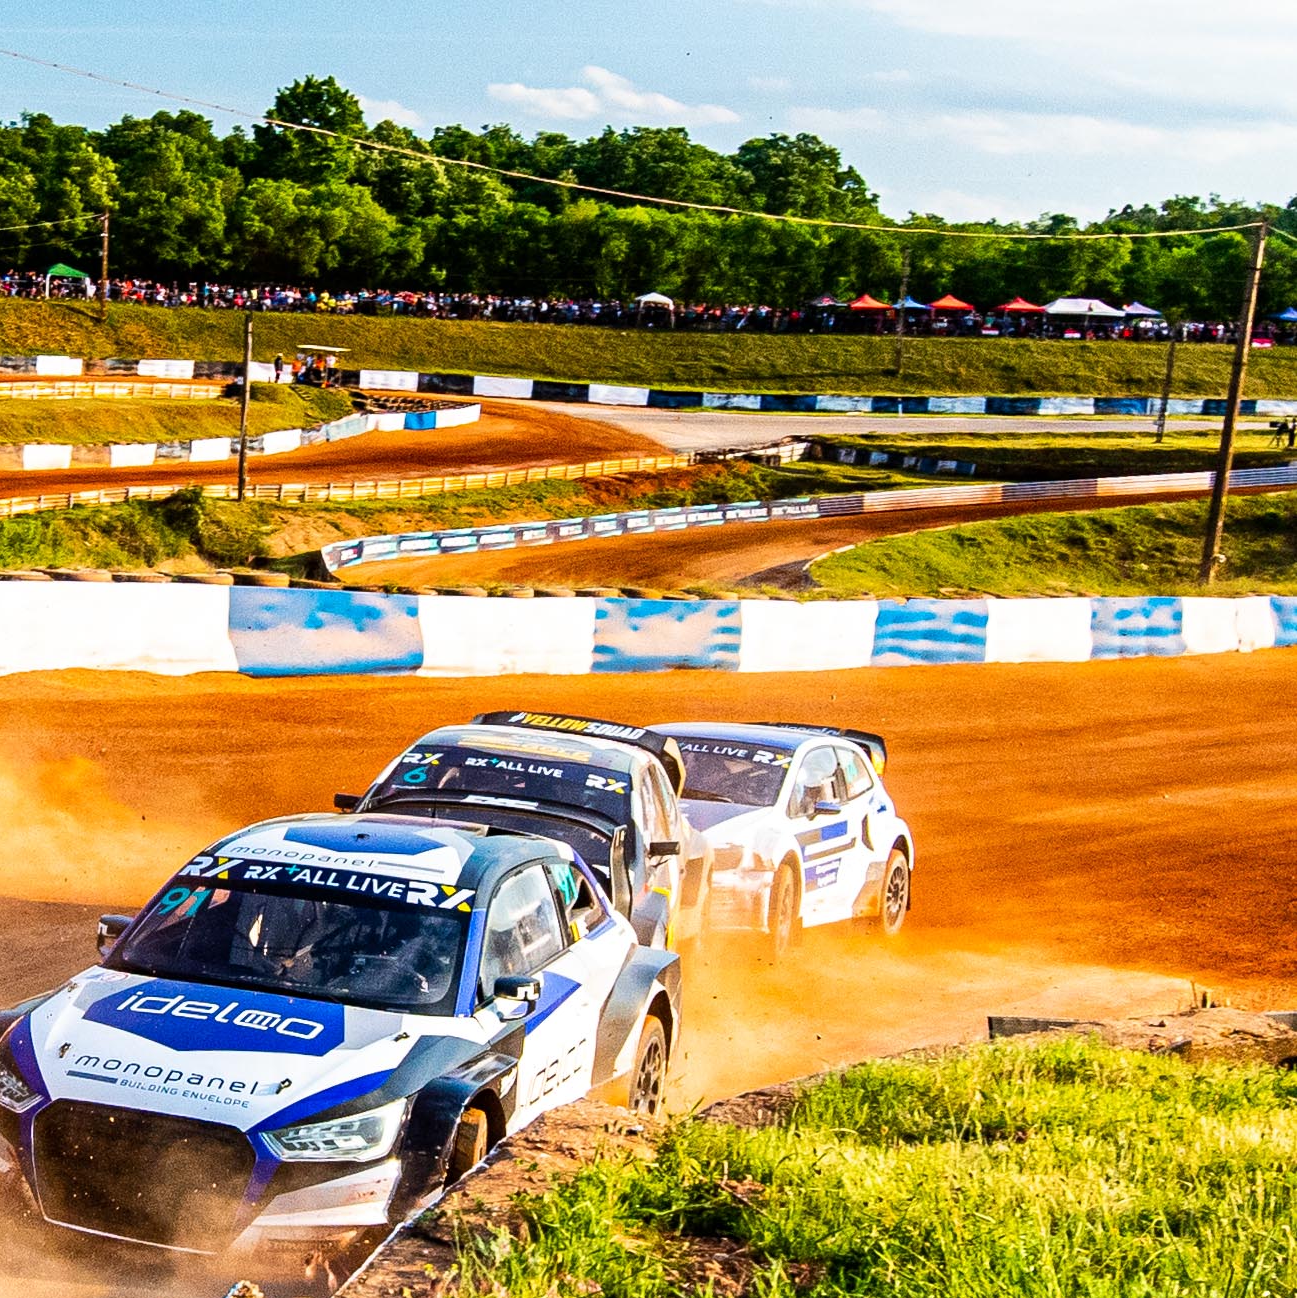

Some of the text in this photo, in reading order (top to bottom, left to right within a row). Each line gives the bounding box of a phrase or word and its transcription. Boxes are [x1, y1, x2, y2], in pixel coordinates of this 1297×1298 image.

[508, 712, 646, 740] #YELLOWSQUAD
[402, 752, 444, 766] RX
[712, 745, 748, 759] LIVE
[752, 750, 793, 769] RX
[403, 766, 428, 784] 6
[496, 760, 525, 772] ALL
[528, 764, 563, 778] LIVE
[585, 773, 628, 795] RX
[179, 856, 244, 880] RX
[230, 845, 374, 868] monopanel
[294, 869, 339, 887] ALL
[347, 876, 406, 899] LIVE
[157, 887, 212, 918] 91
[406, 882, 476, 913] RX
[75, 1053, 258, 1096] monopanel
[119, 1077, 250, 1109] BUILDING ENVELOPE
